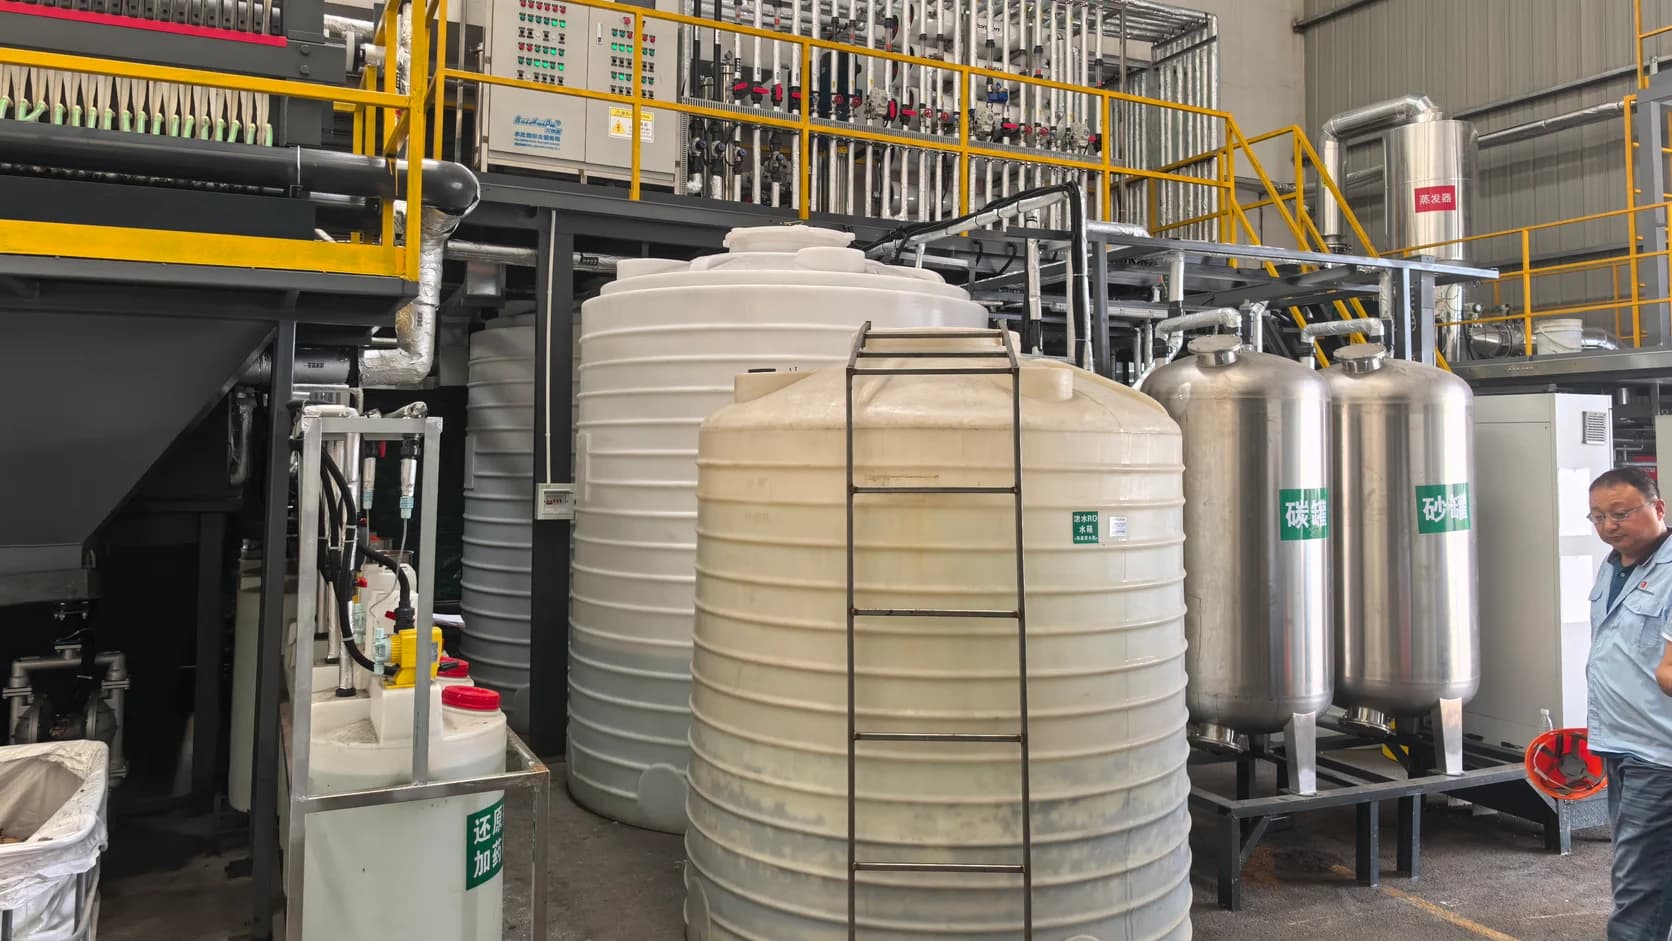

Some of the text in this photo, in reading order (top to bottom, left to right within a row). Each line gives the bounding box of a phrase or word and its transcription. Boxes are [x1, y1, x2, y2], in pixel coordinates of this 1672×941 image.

[1418, 192, 1452, 207] 蒸发器
[1285, 499, 1327, 529] 碳罐
[1422, 494, 1469, 523] 砂罐
[473, 804, 503, 846] 还原
[473, 838, 503, 879] 加药
